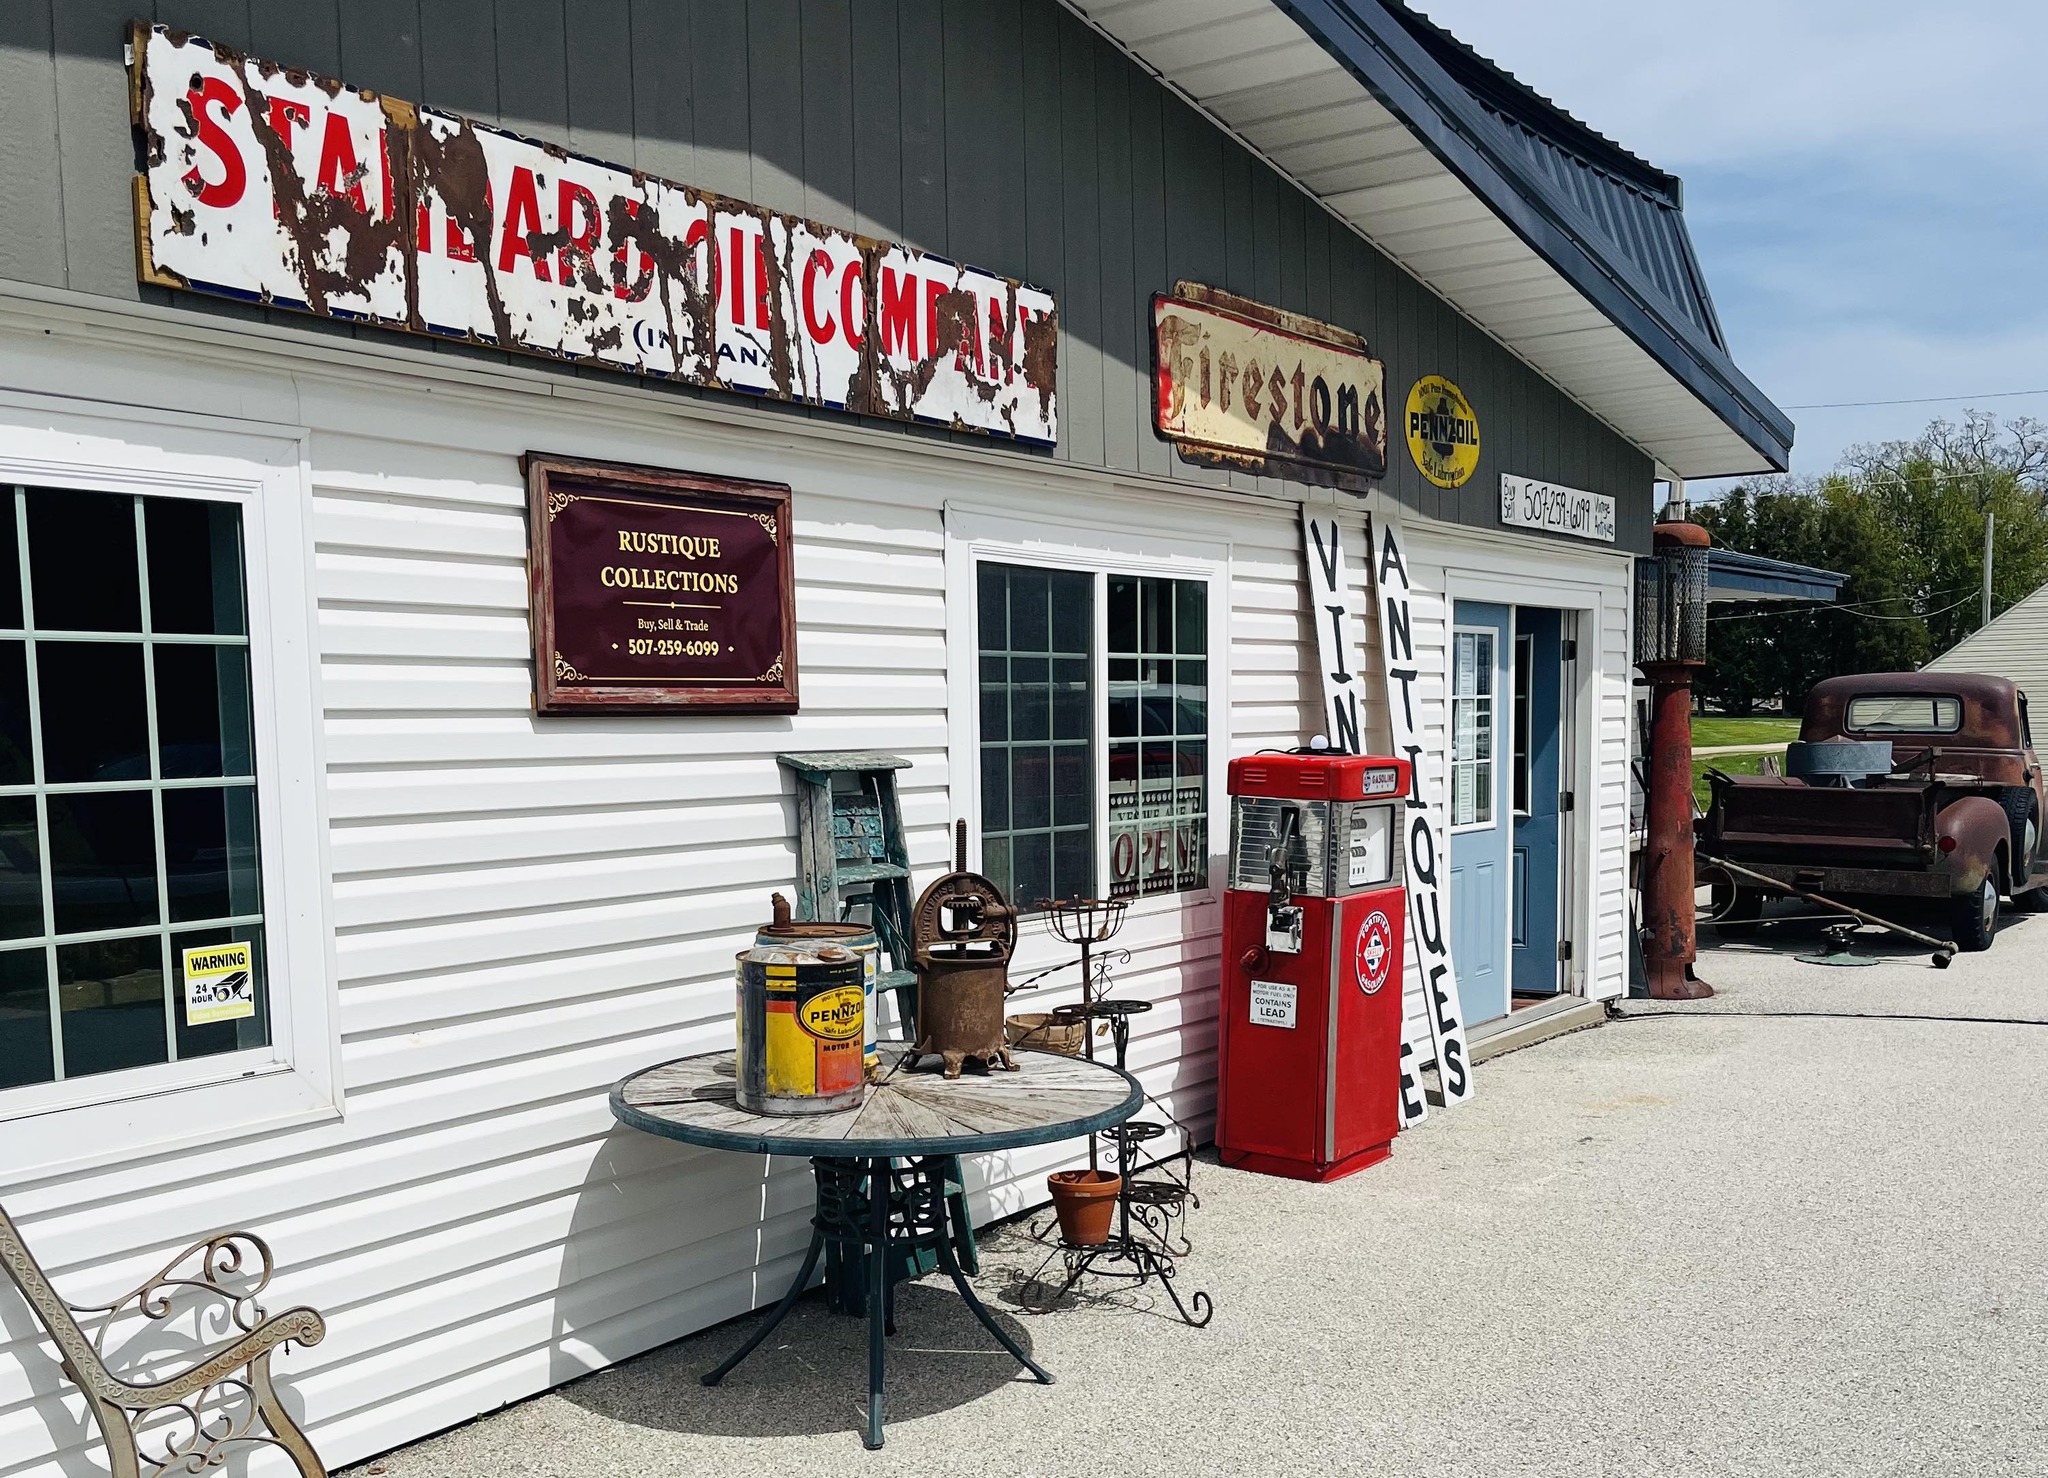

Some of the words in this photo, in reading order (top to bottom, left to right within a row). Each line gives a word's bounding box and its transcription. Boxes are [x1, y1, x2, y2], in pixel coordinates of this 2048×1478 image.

[803, 249, 1049, 389] COMPAN
[1158, 314, 1381, 446] Firestone
[1410, 412, 1478, 446] PENNZOIL
[1504, 477, 1516, 501] Buy
[618, 530, 721, 560] RUSTIQUE
[600, 566, 738, 594] COLLECTIONS
[638, 618, 657, 632] Buy,
[658, 619, 674, 631] Sell
[675, 620, 683, 631] &
[684, 620, 708, 632] Trade
[628, 638, 719, 656] 507-259-6099
[1380, 524, 1466, 1097] ANTIQUES
[1113, 827, 1190, 879] OPEN
[191, 952, 245, 971] WARNING
[192, 994, 213, 1004] HOUR
[196, 984, 207, 994] 24
[1255, 997, 1291, 1008] CONTAINS
[1260, 1007, 1286, 1018] LEAD
[823, 1042, 850, 1051] MOTOR
